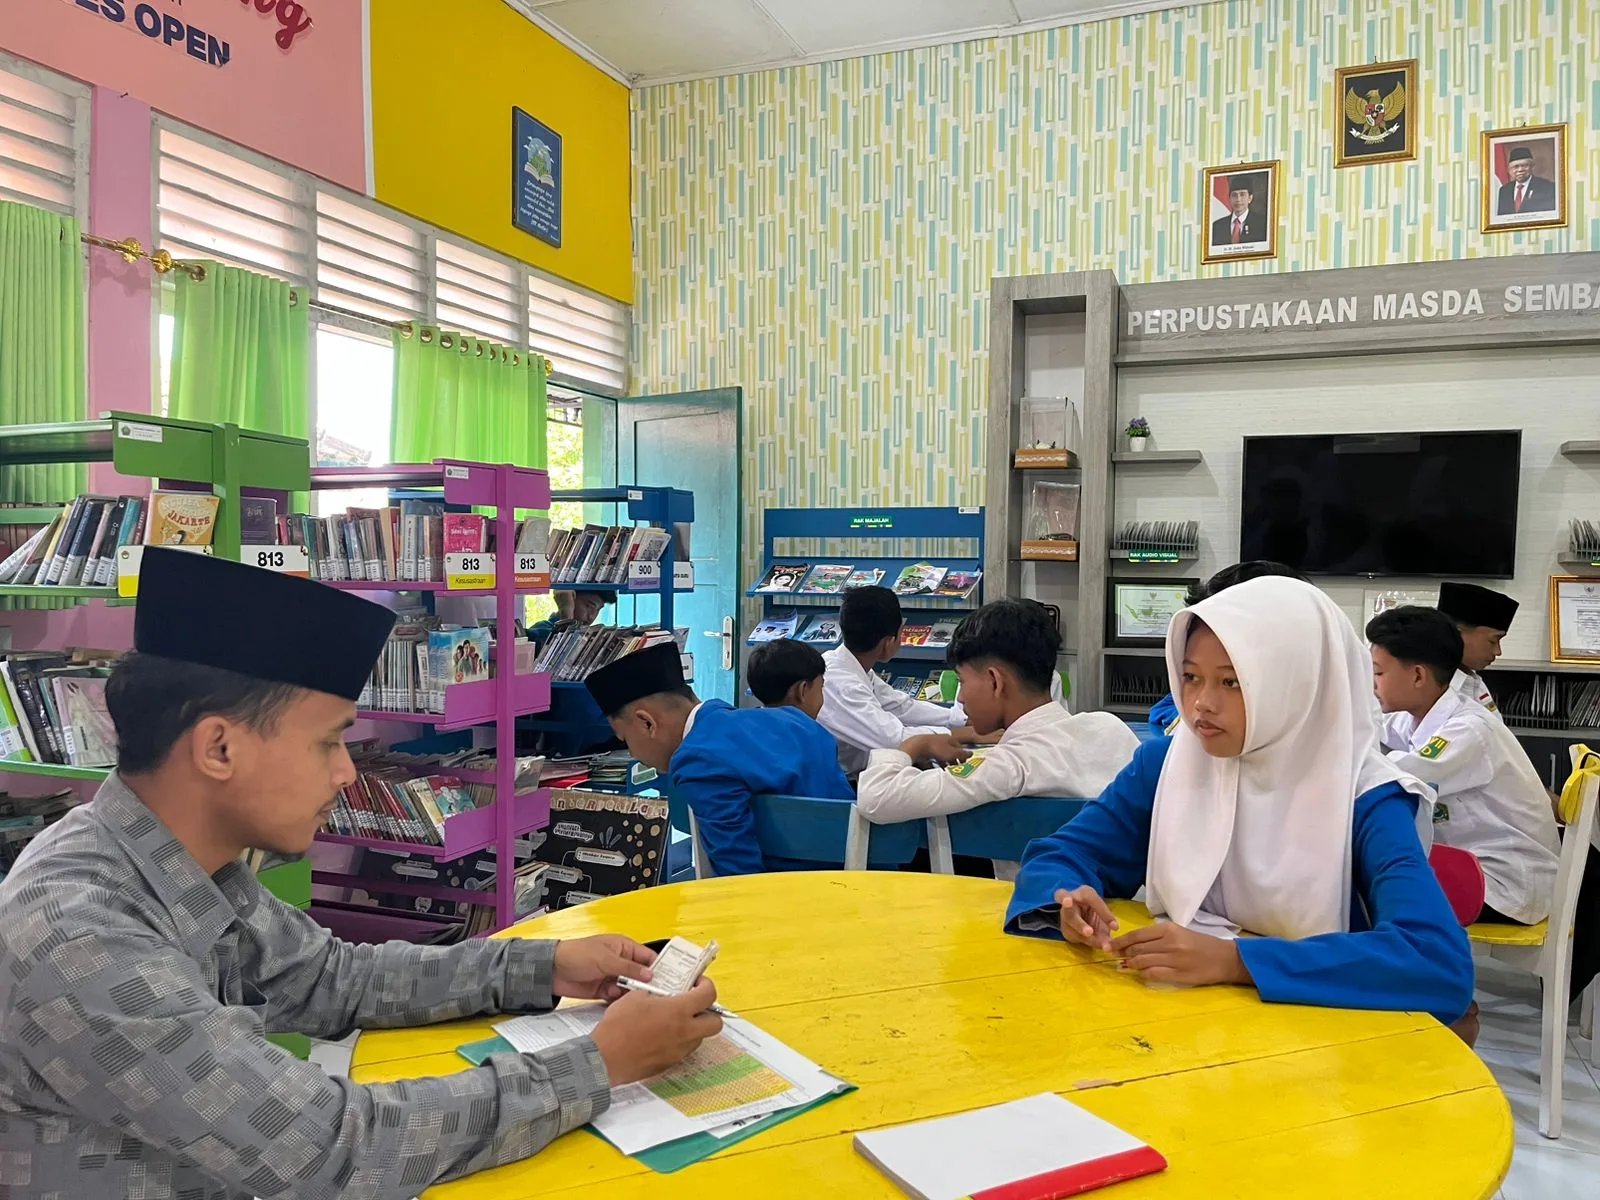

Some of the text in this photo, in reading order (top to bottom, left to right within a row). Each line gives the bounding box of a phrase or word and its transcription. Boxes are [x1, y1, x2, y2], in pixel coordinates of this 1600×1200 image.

[134, 3, 230, 66] OPEN
[1127, 296, 1357, 335] PERPUSTAKAAN
[1372, 289, 1485, 320] MASDA
[257, 552, 284, 567] 813
[462, 558, 480, 571] 813
[520, 558, 536, 570] 813
[638, 565, 652, 575] 900
